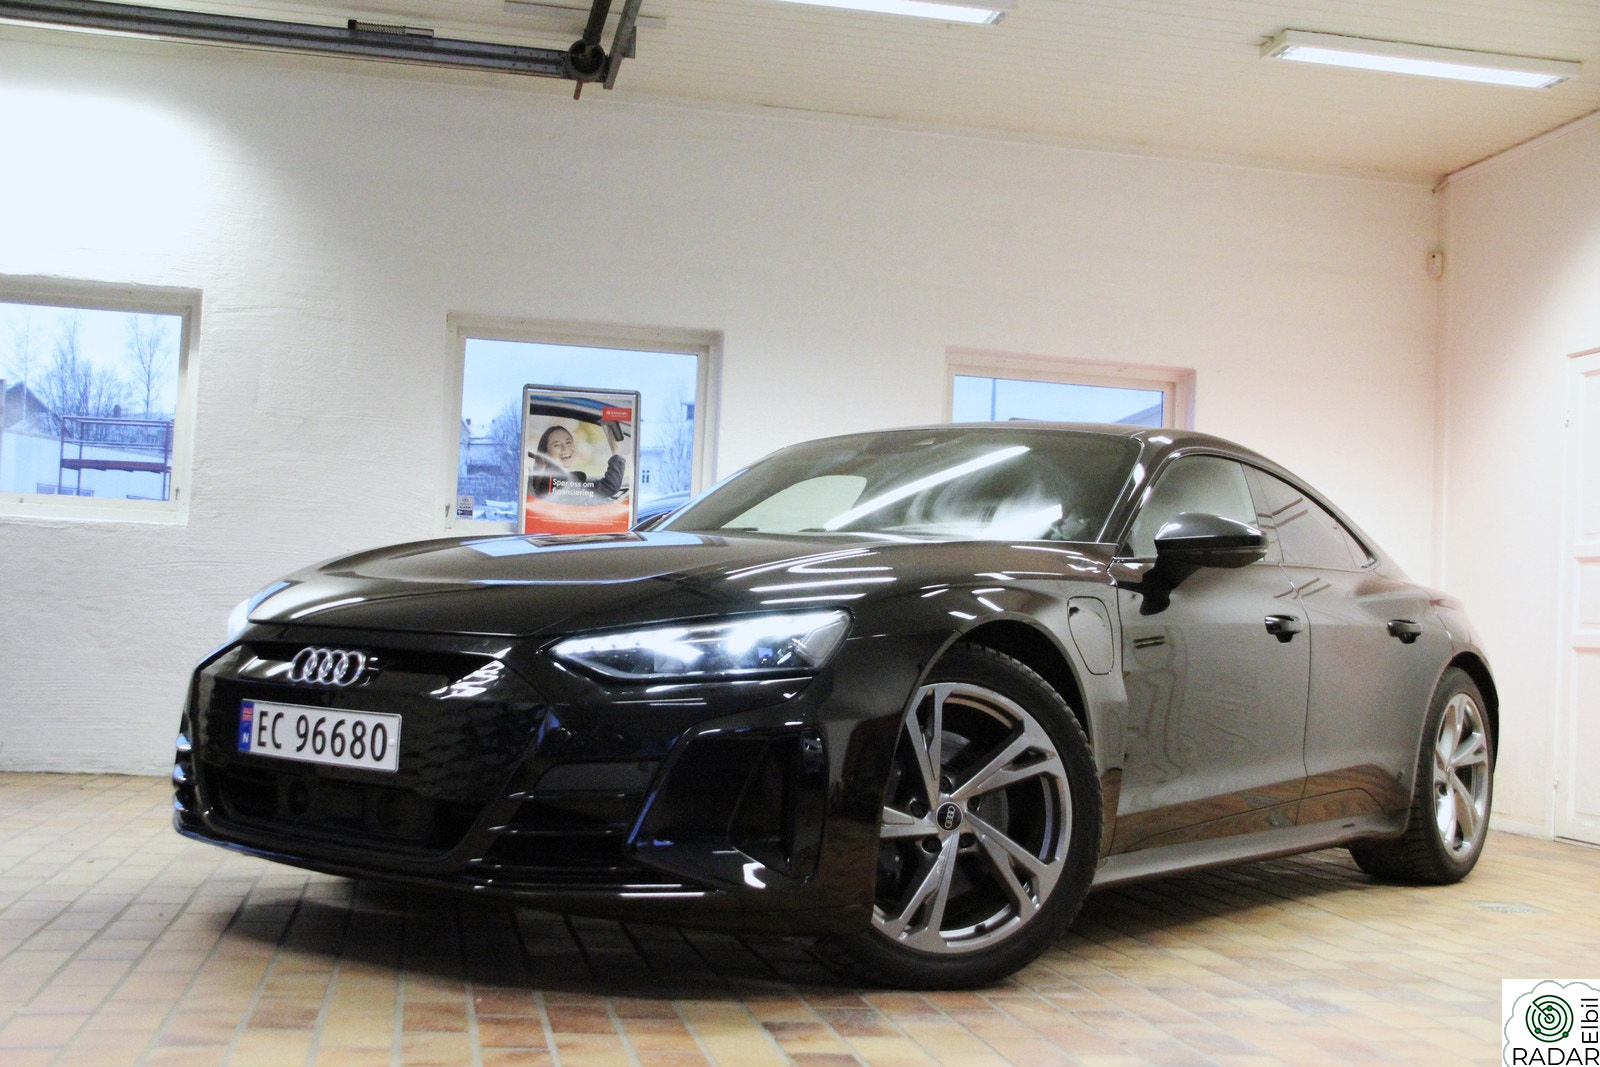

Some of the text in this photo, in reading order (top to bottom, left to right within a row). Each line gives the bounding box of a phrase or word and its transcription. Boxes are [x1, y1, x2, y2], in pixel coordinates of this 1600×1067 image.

[552, 487, 595, 498] finansiering
[242, 732, 249, 744] N
[257, 710, 388, 762] EC 96680
